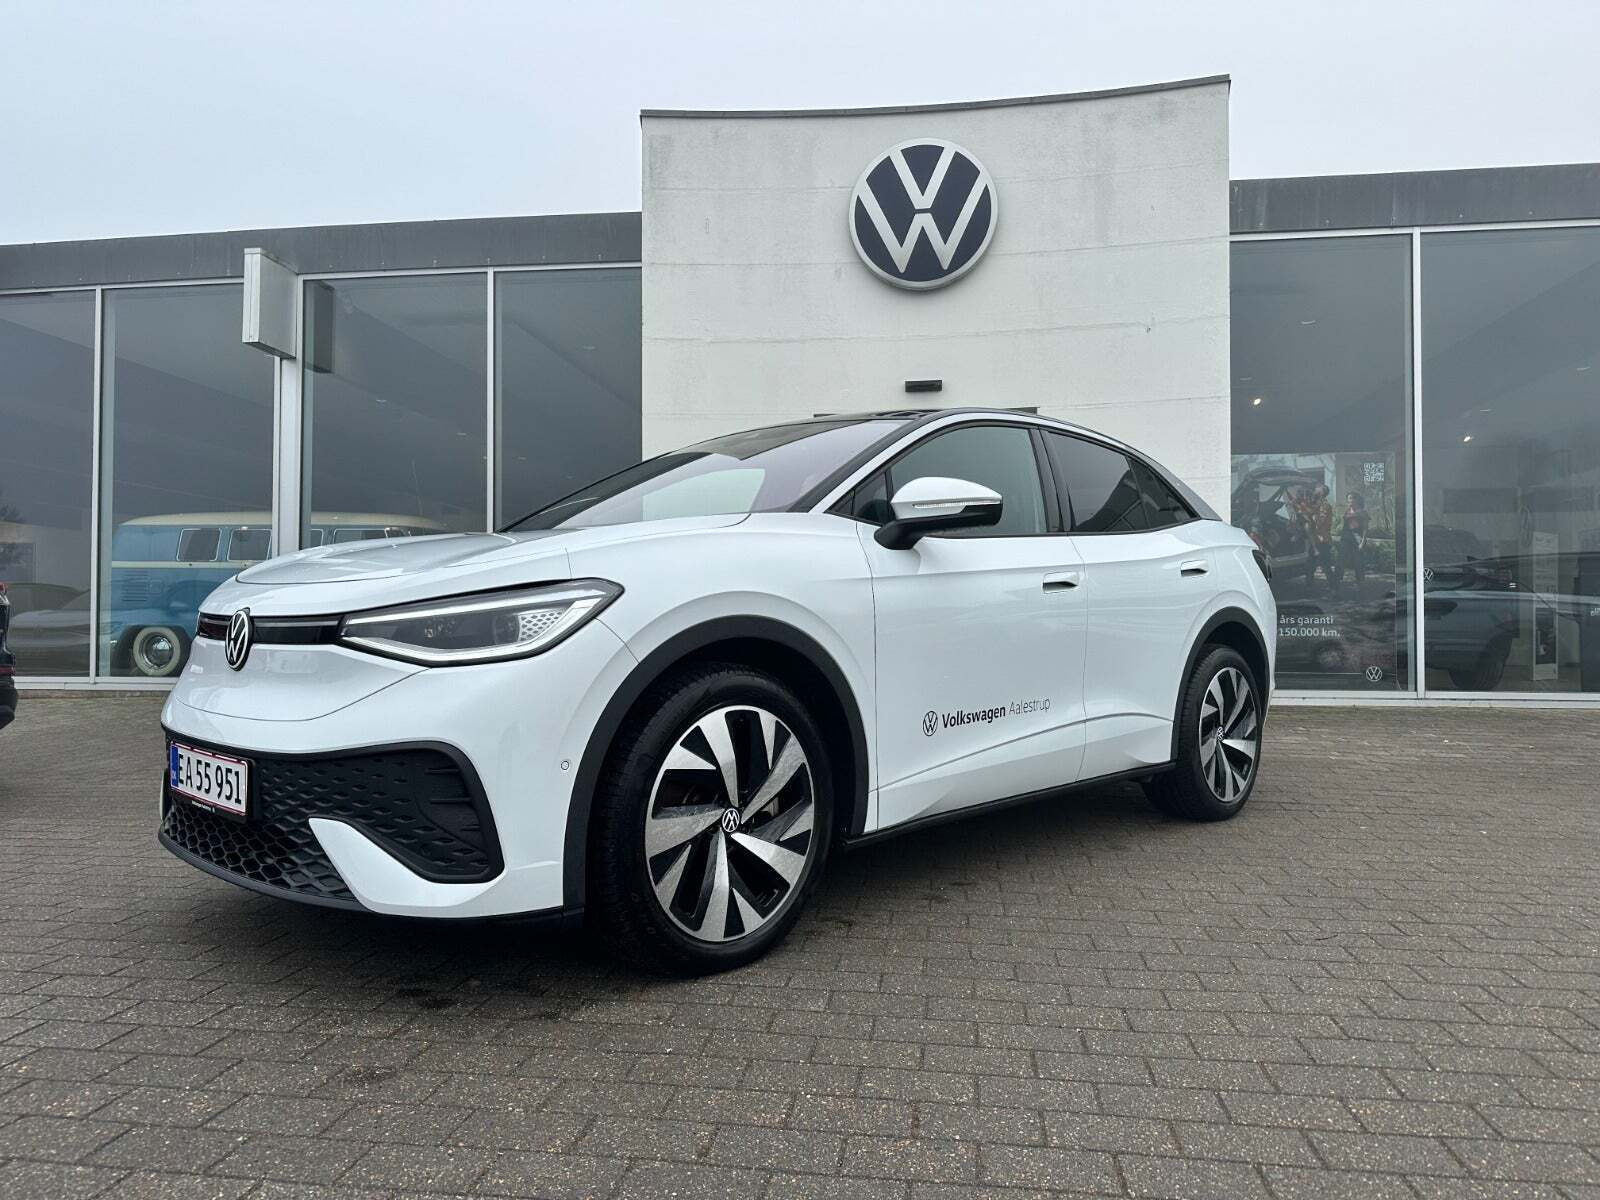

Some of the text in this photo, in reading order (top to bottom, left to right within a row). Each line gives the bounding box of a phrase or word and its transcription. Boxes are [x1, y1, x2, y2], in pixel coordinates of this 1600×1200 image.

[851, 140, 996, 288] VW
[1279, 615, 1334, 626] års garanti
[1279, 628, 1341, 637] 150.000 km.
[942, 705, 1006, 728] Volkswagen
[1009, 697, 1051, 716] Aalestrup
[178, 753, 242, 805] EA 55 951
